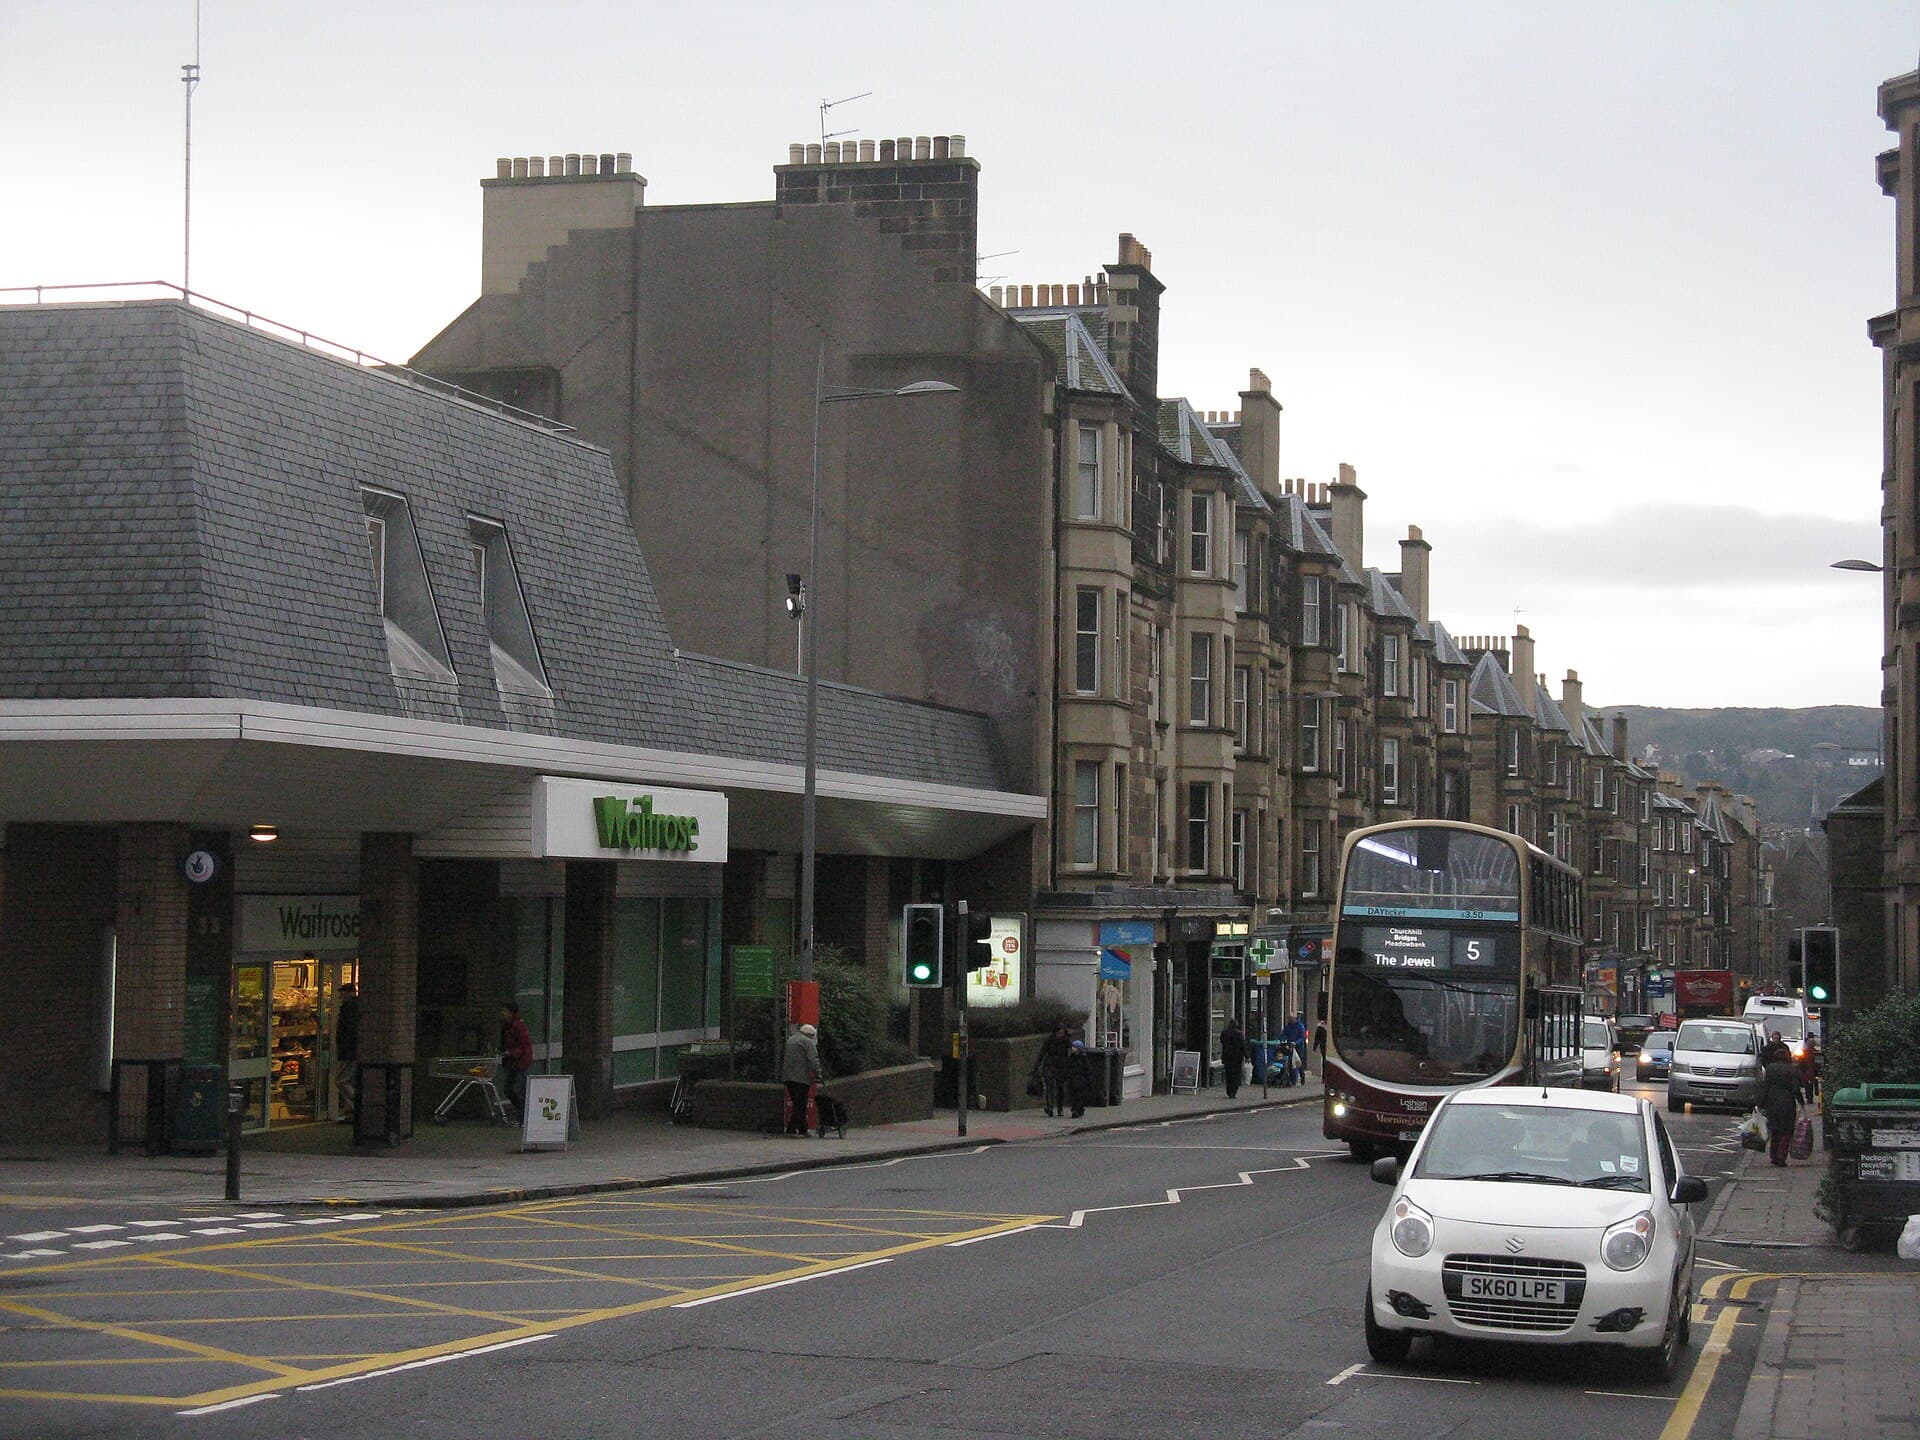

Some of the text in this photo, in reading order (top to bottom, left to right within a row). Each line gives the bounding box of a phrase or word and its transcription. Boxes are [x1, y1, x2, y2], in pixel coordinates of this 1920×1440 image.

[592, 794, 699, 852] Waitrose
[279, 902, 360, 940] Waitrose
[1374, 953, 1436, 968] The Jewel
[1466, 940, 1480, 961] 5
[1471, 1278, 1558, 1300] SK60 LPE
